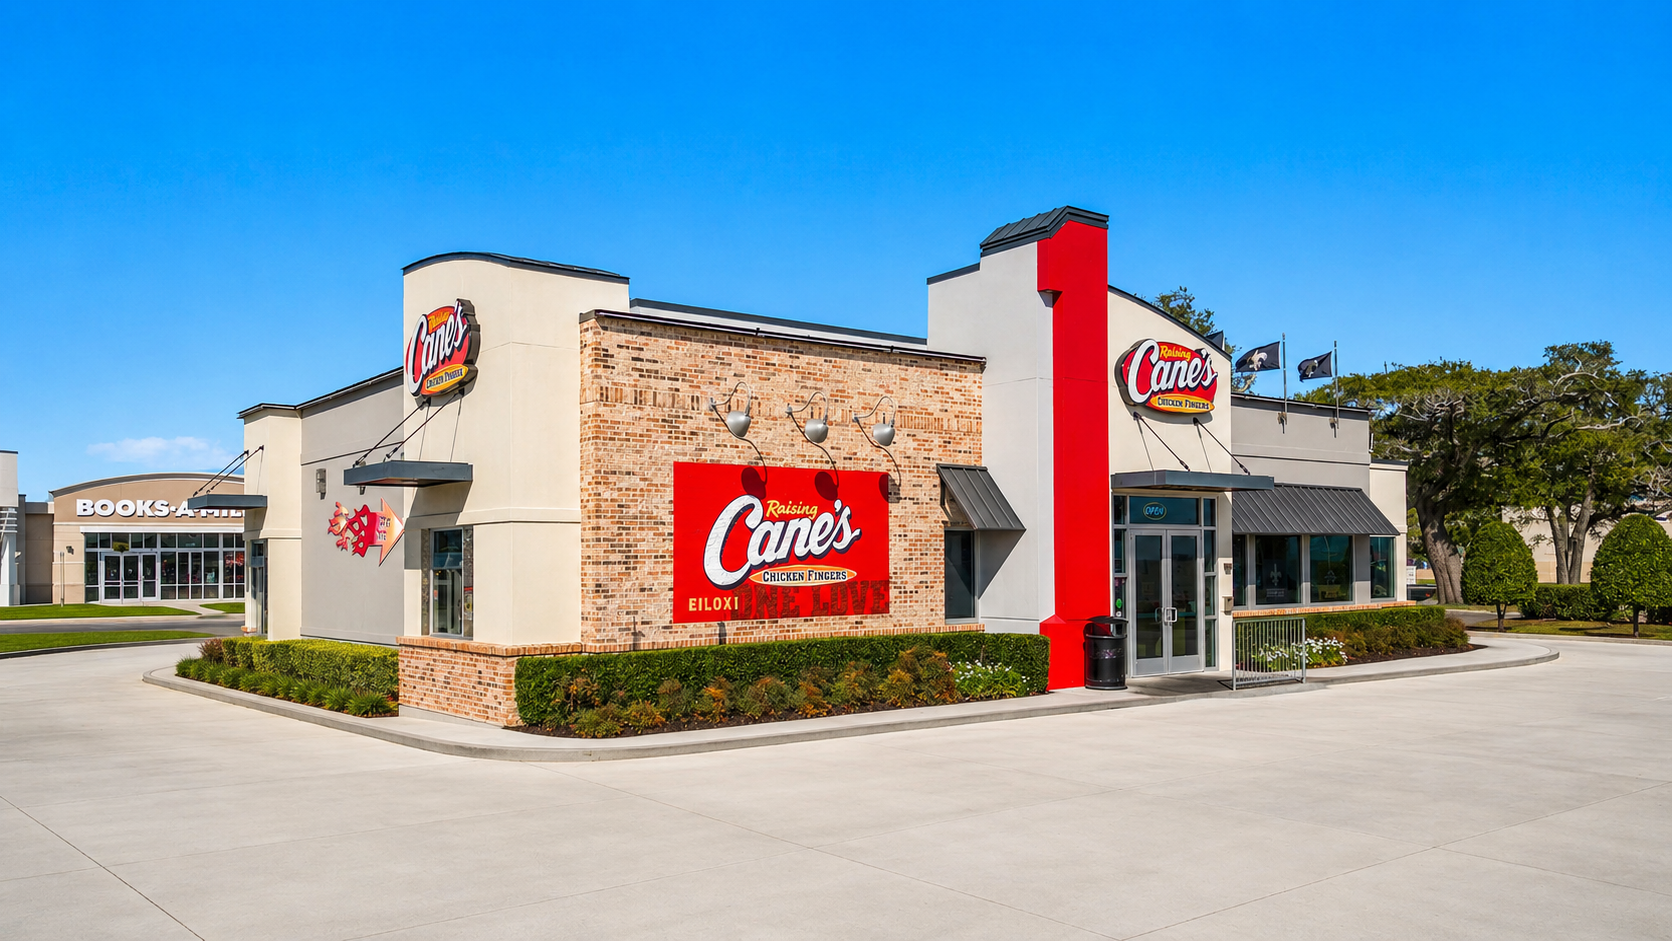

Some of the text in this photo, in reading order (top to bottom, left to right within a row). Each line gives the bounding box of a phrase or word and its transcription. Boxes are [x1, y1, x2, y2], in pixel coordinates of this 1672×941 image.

[1128, 339, 1218, 403] Cane's
[766, 499, 818, 520] Raising
[704, 494, 862, 589] Cane's
[762, 569, 848, 582] CHICKEN FINGERS
[731, 580, 889, 620] ONE LOVE
